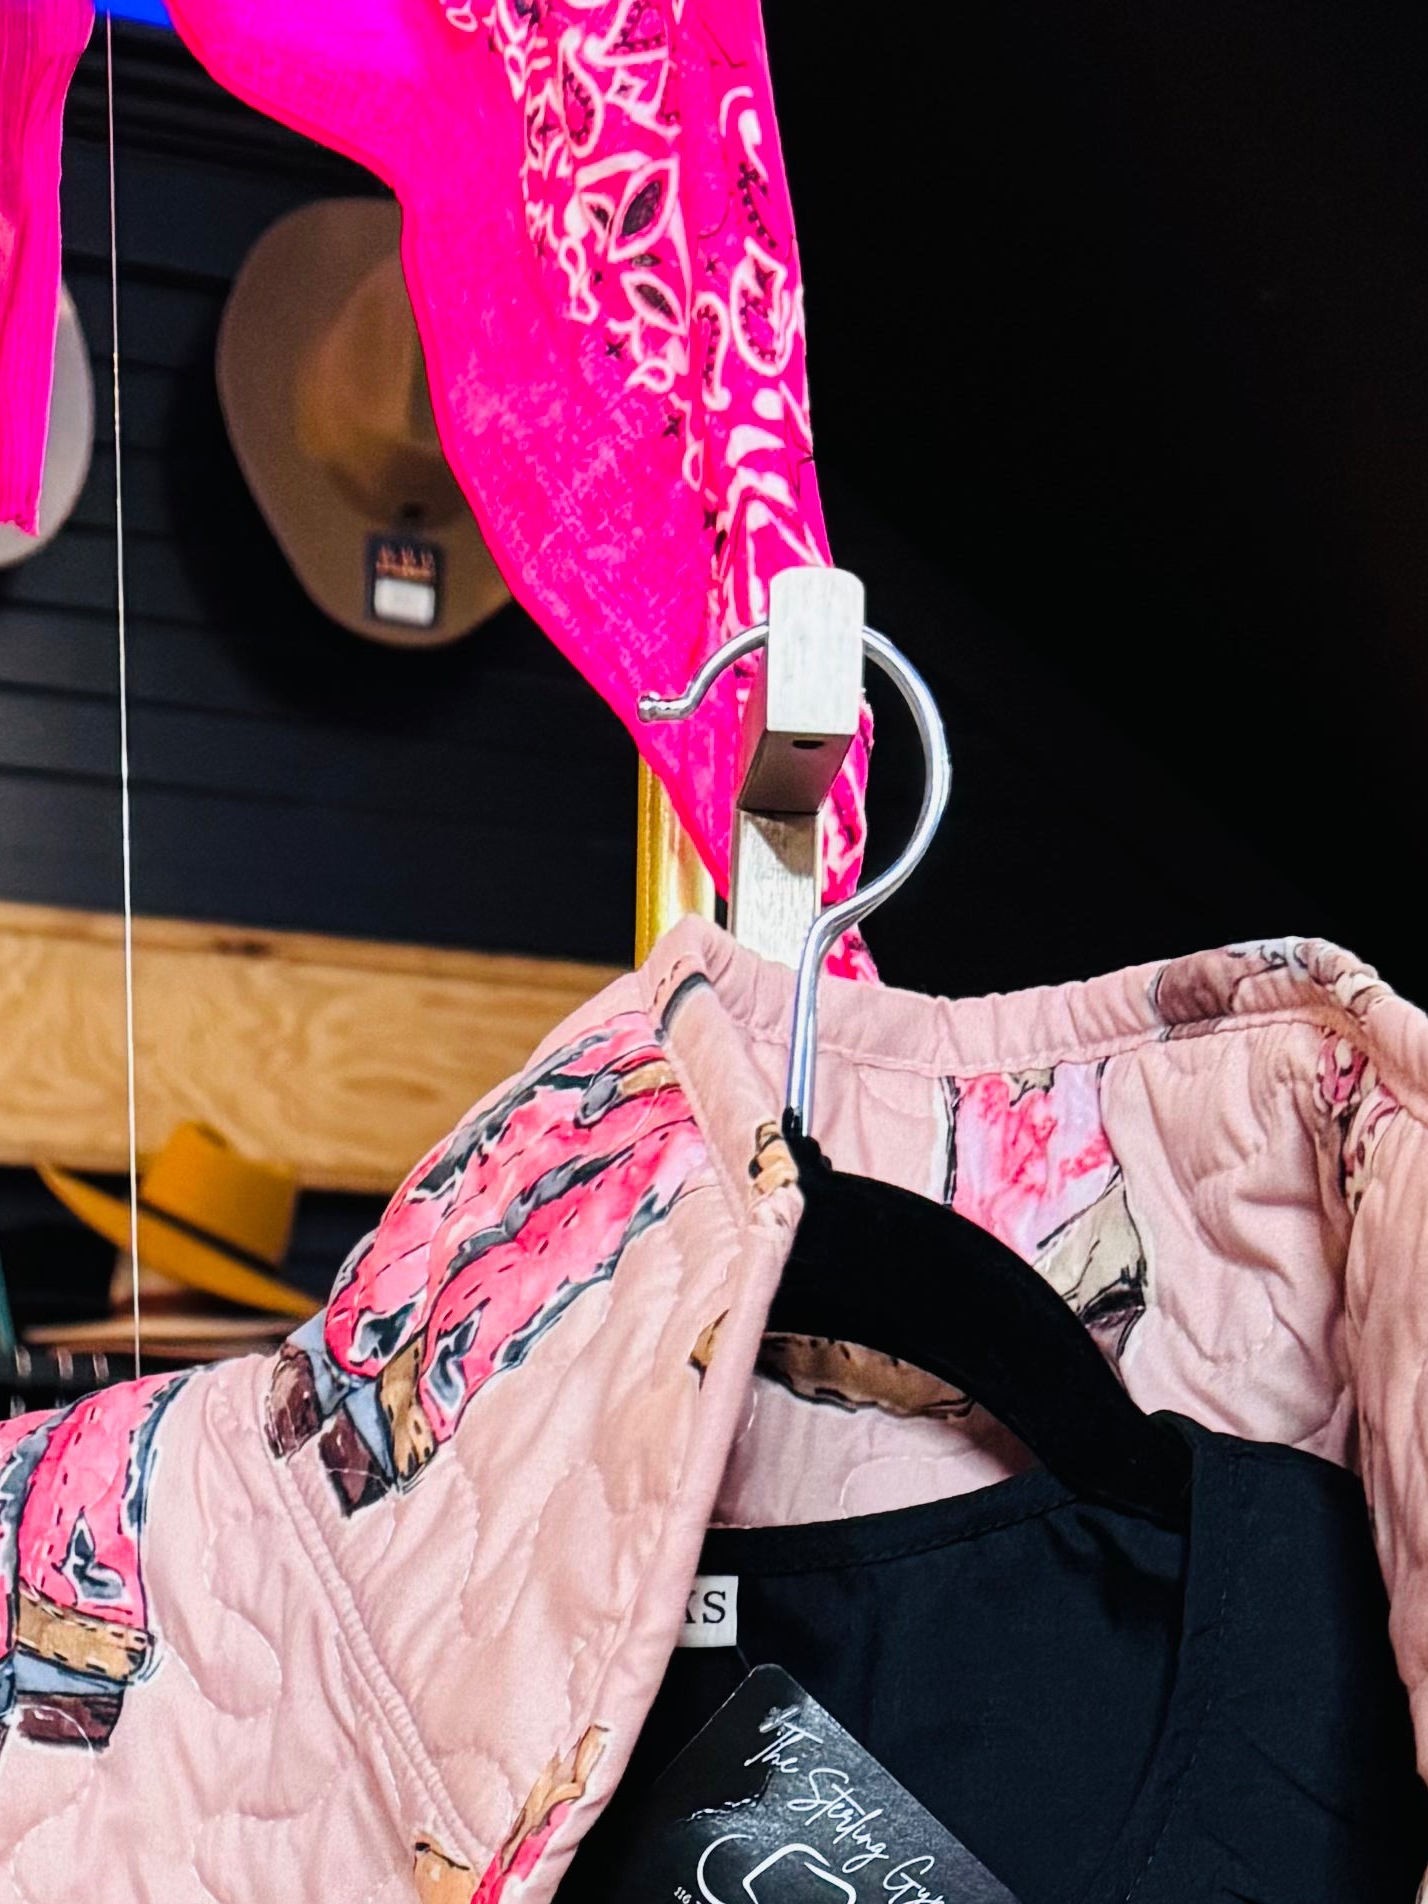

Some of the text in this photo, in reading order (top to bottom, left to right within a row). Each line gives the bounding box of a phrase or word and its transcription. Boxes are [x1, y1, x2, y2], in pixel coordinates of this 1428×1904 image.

[744, 1721, 824, 1774] The
[787, 1767, 890, 1874] Sterling
[674, 1886, 692, 1904] 116
